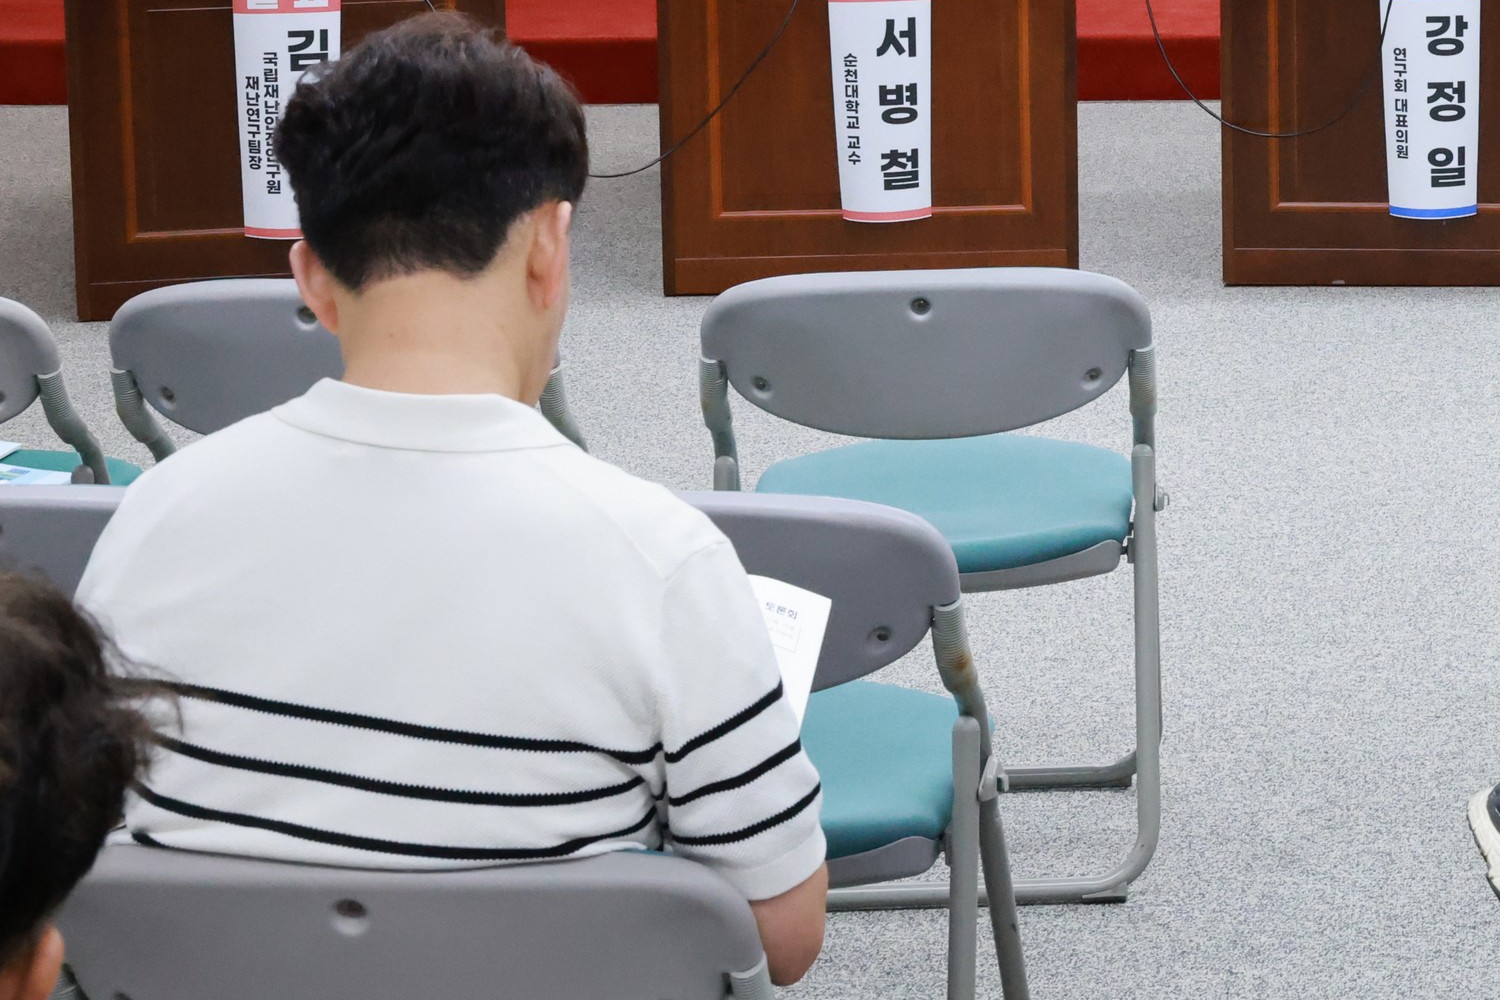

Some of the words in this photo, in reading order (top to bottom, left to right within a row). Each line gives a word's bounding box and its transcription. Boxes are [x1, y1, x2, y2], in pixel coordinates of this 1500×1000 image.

[843, 53, 860, 130] 순천대학교
[876, 17, 921, 191] 서병철
[1393, 47, 1408, 93] 연구회
[1425, 15, 1469, 188] 강정일
[245, 75, 262, 170] 재난연구팀장
[847, 135, 862, 166] 교수
[1394, 98, 1409, 160] 대표의원
